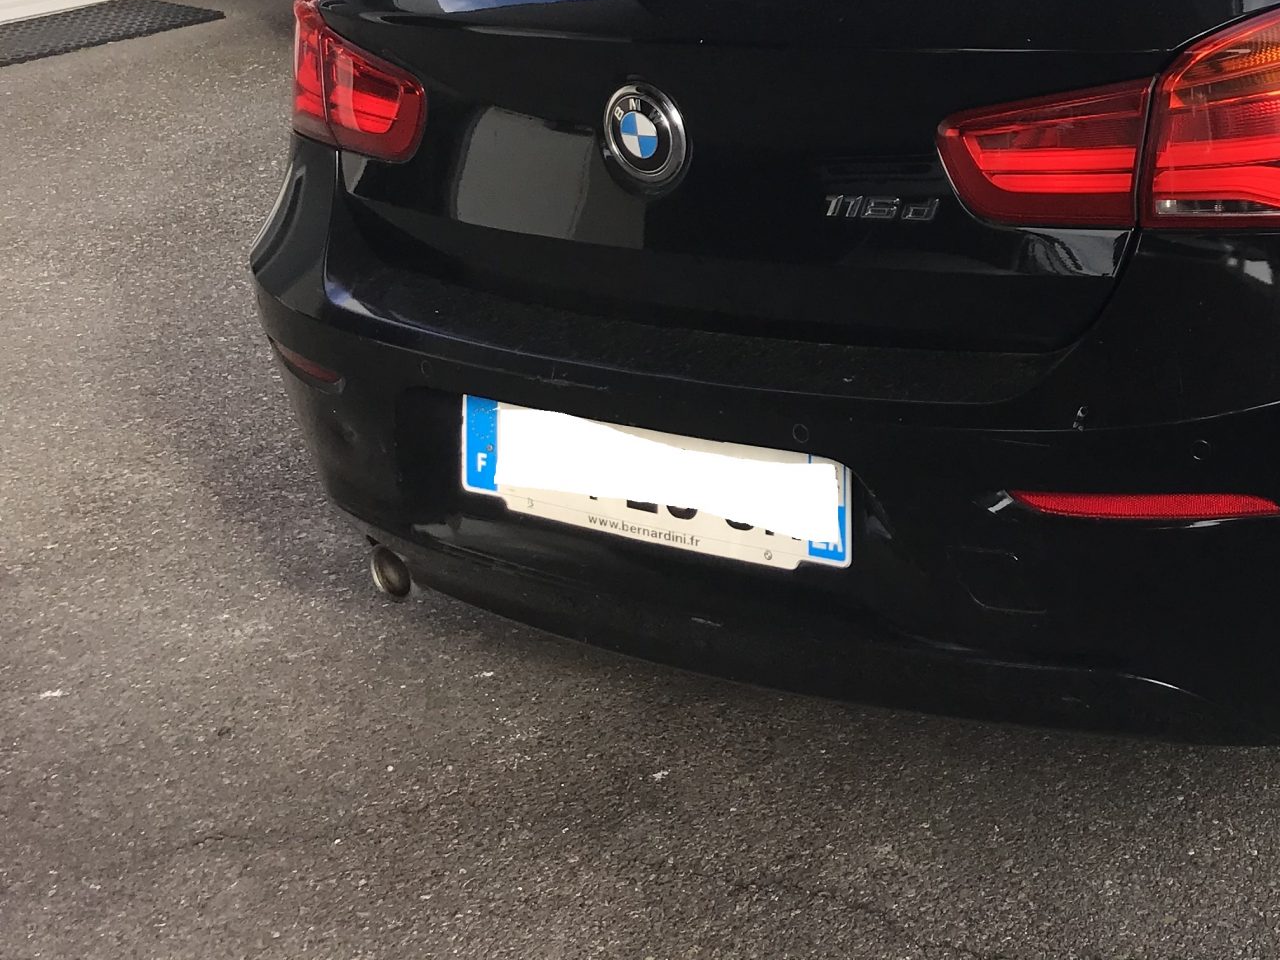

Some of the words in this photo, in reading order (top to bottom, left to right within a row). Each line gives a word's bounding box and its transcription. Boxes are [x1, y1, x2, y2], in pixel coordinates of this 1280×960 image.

[614, 98, 669, 125] BMW
[476, 452, 487, 473] F
[588, 514, 701, 547] www.bernardini.fr
